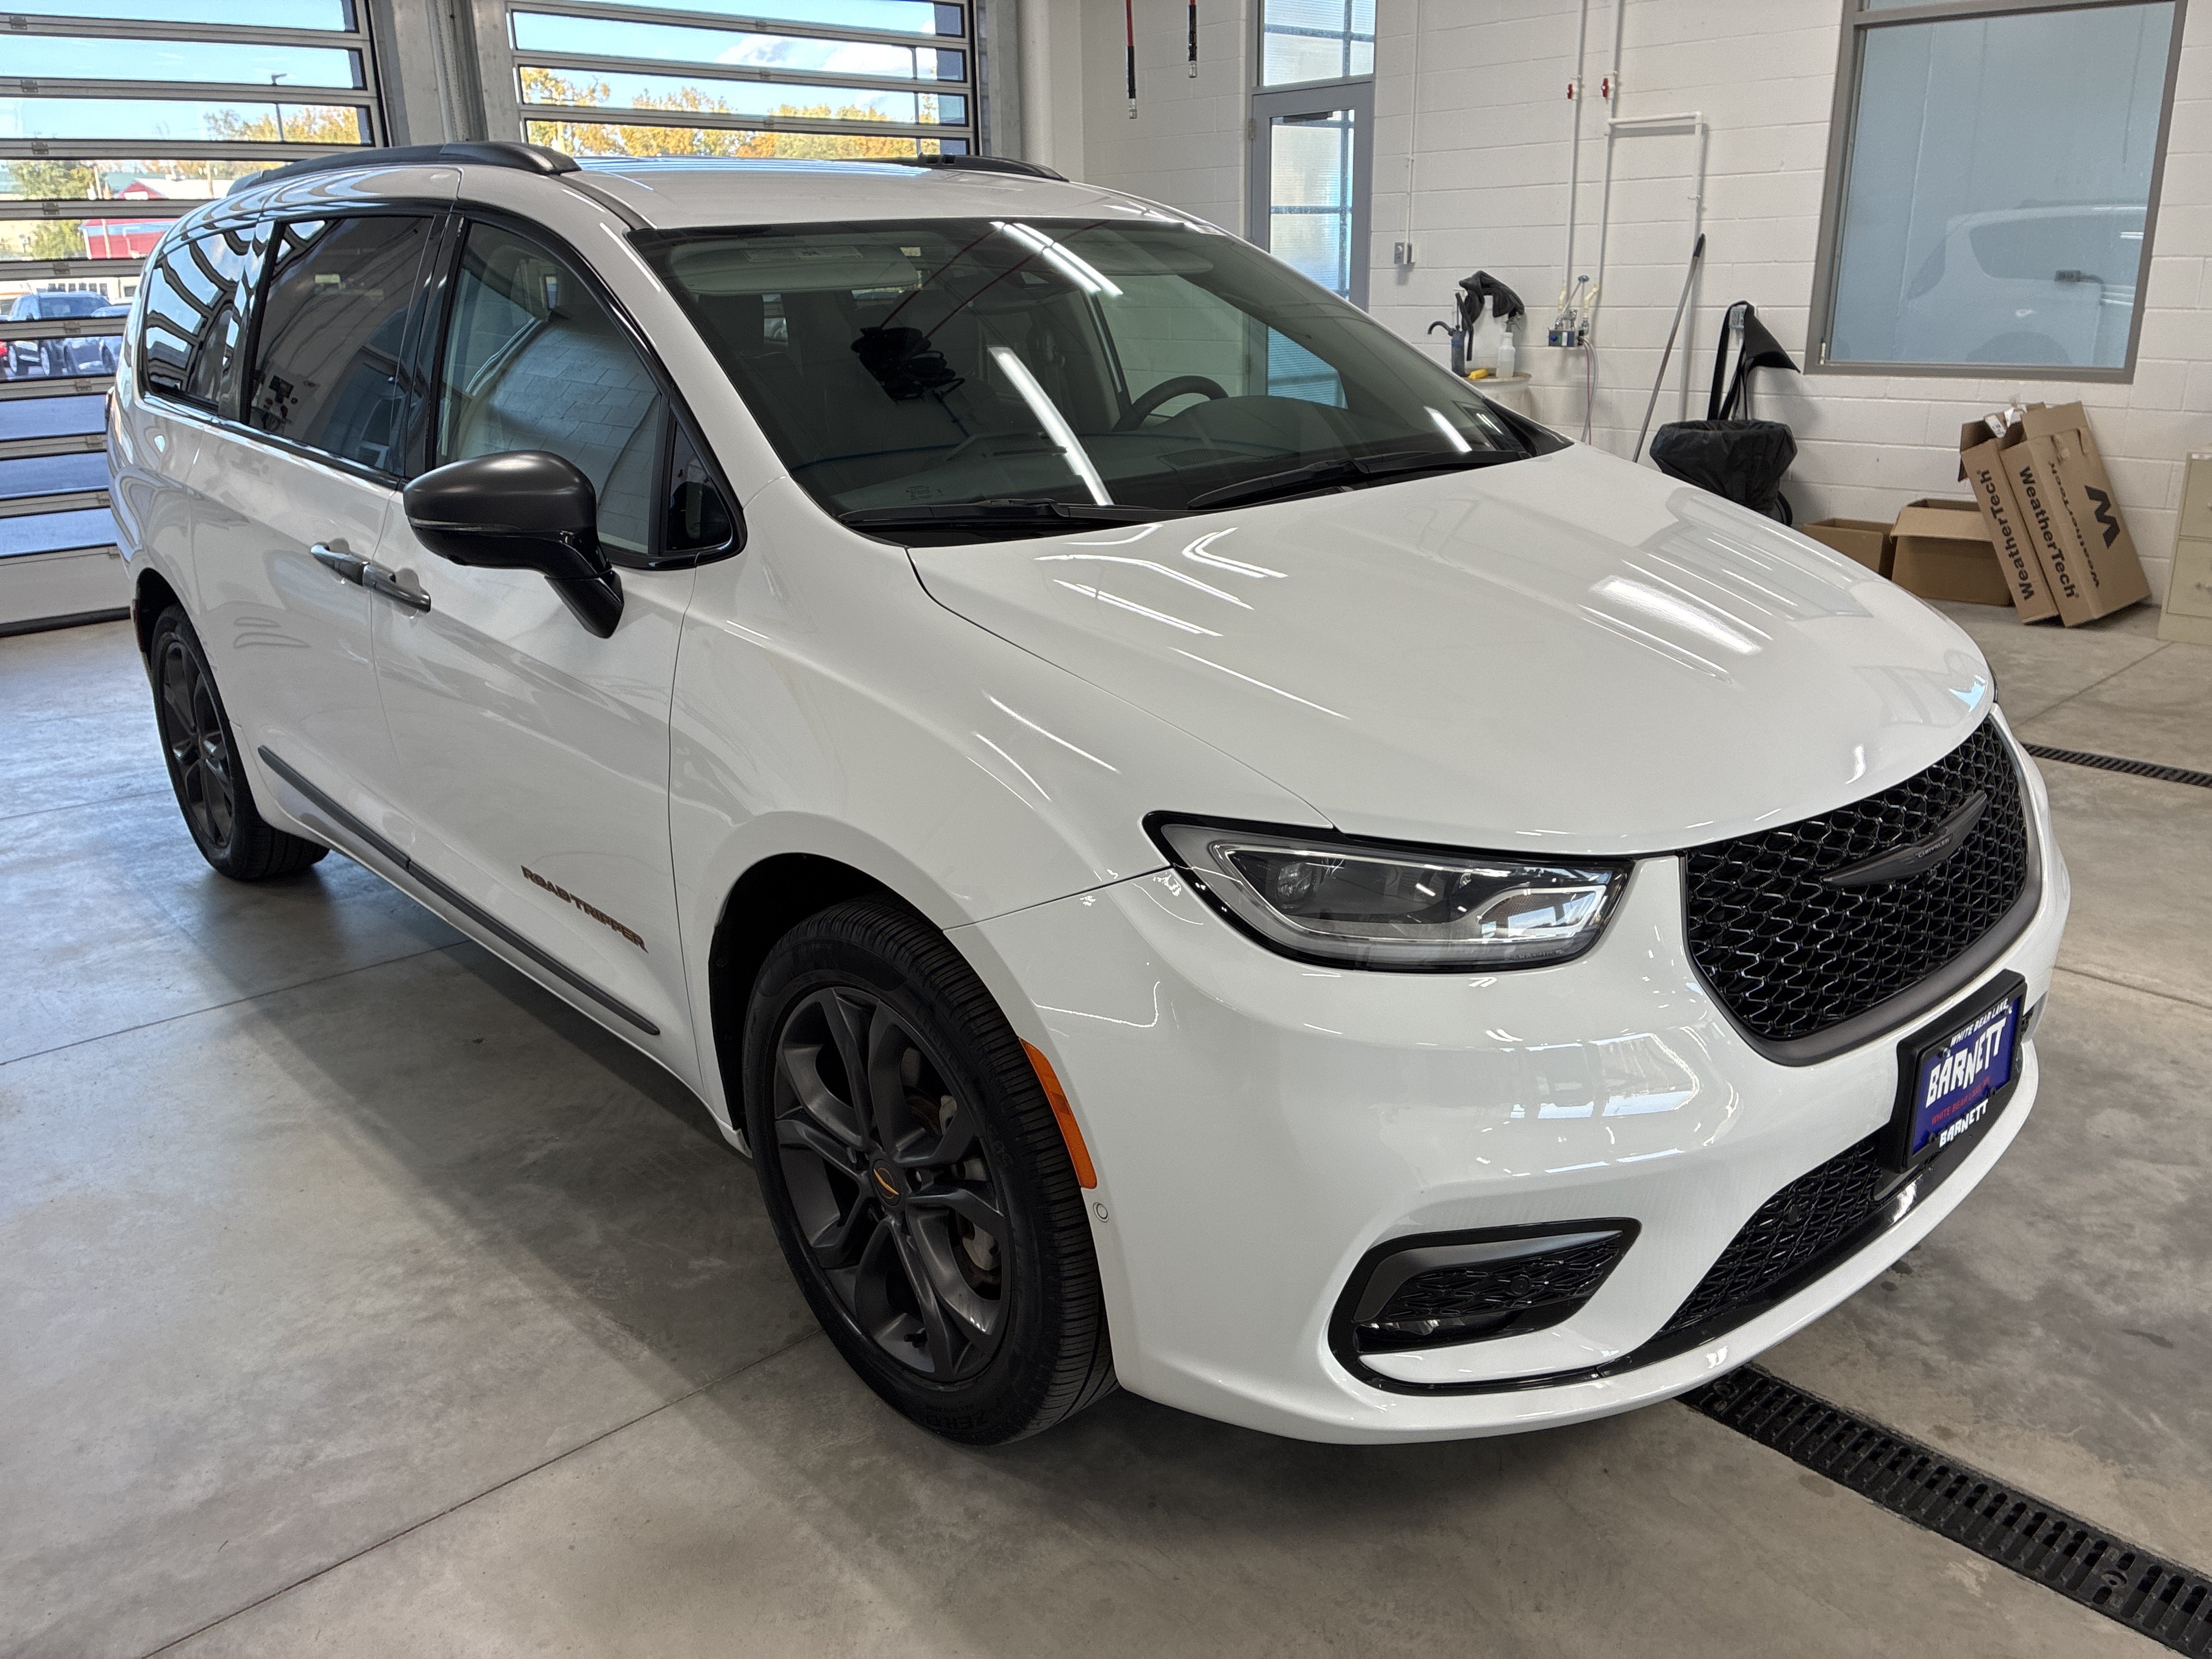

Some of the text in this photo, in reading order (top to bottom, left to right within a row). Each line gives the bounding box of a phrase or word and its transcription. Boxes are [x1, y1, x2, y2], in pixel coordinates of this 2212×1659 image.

[1980, 469, 2035, 601] WeatherTech
[2019, 465, 2076, 598] WeatherTech
[1918, 837, 1950, 859] CHRYSLER
[1925, 1016, 2007, 1109] BARNETT
[1950, 1023, 1974, 1047] WHITE
[1973, 1010, 1992, 1033] BEAR
[1939, 1098, 1989, 1148] BARNETT
